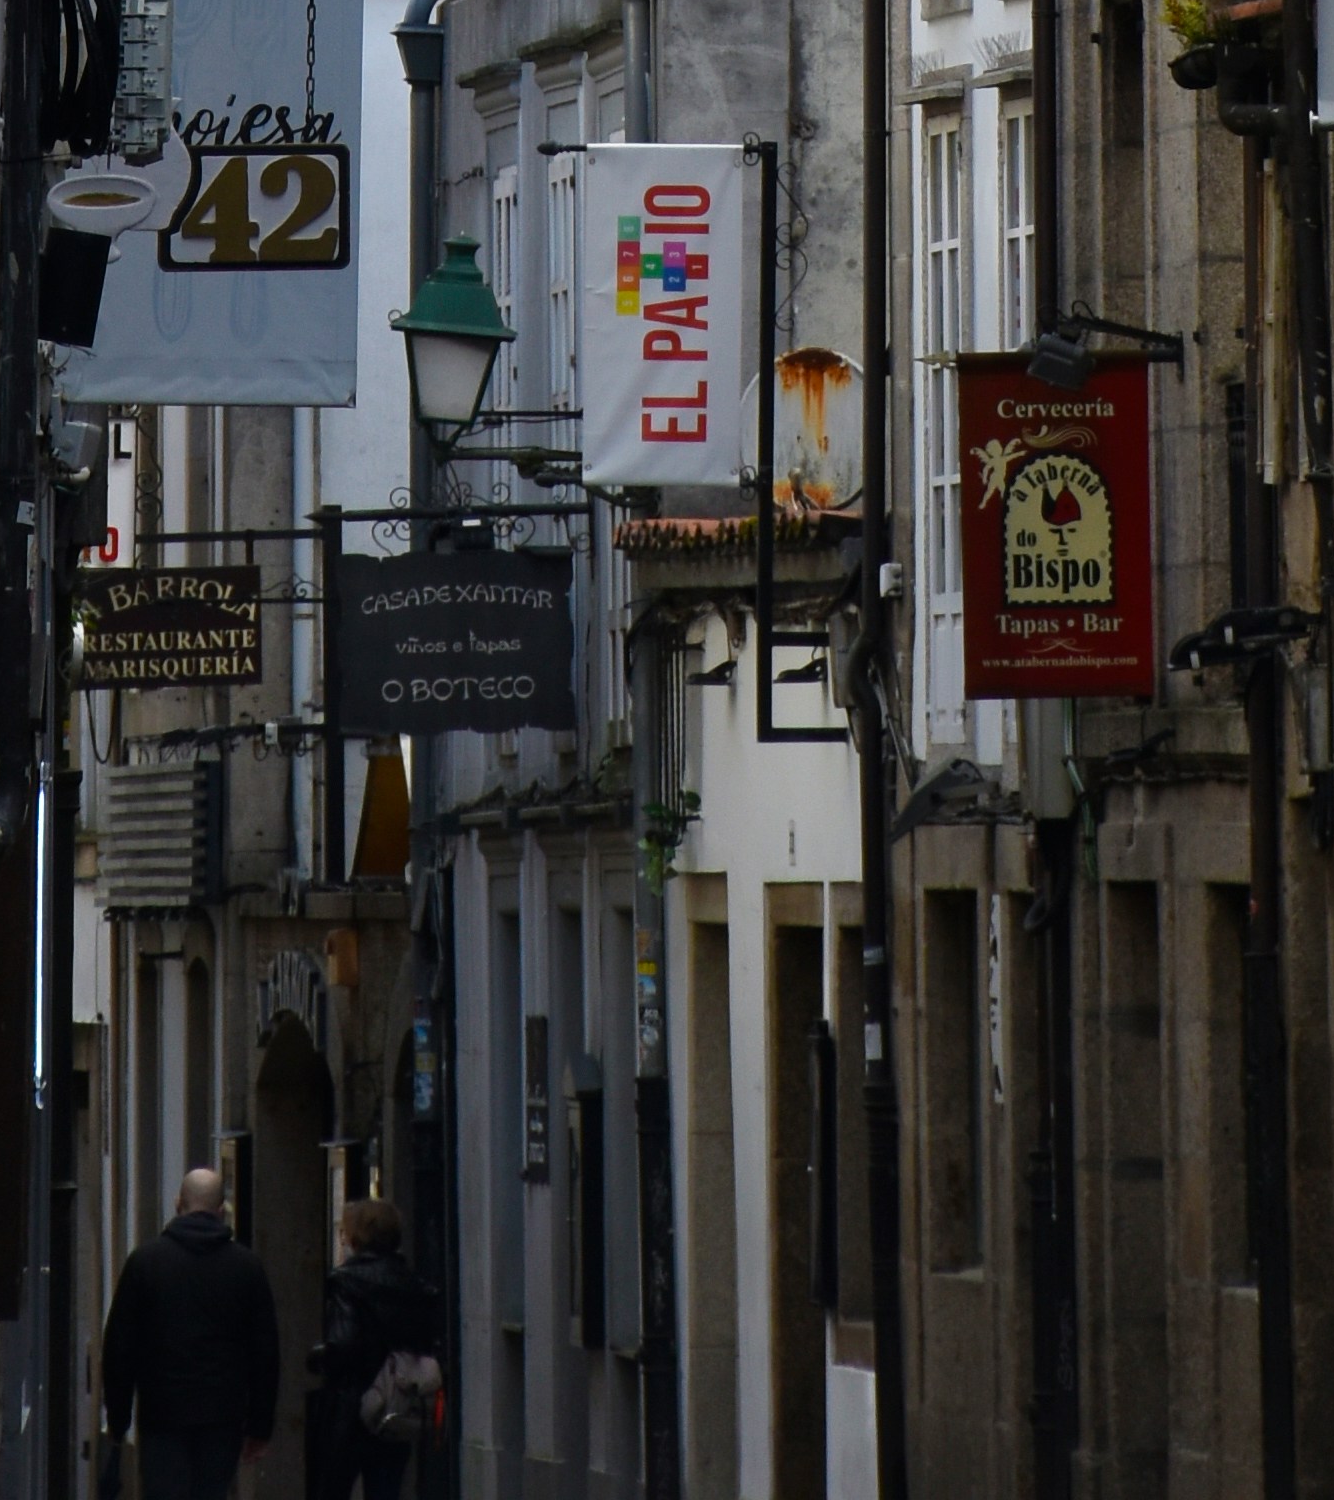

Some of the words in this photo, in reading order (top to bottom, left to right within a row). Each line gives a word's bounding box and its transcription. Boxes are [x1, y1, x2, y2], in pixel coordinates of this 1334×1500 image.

[181, 155, 340, 263] 42
[641, 381, 708, 442] EL
[997, 397, 1115, 419] Cervecería
[1022, 462, 1101, 496] Taberna
[1017, 529, 1037, 547] do
[1012, 553, 1100, 593] Bispo
[995, 613, 1061, 639] Tapas
[1082, 612, 1124, 633] Bar
[83, 628, 256, 653] RESTAURANTE
[452, 643, 463, 653] e
[83, 650, 256, 680] MARISQUERÍA
[981, 654, 1139, 670] www.atabernadobispo.com
[381, 680, 404, 703] O
[410, 676, 535, 702] BOTECO
